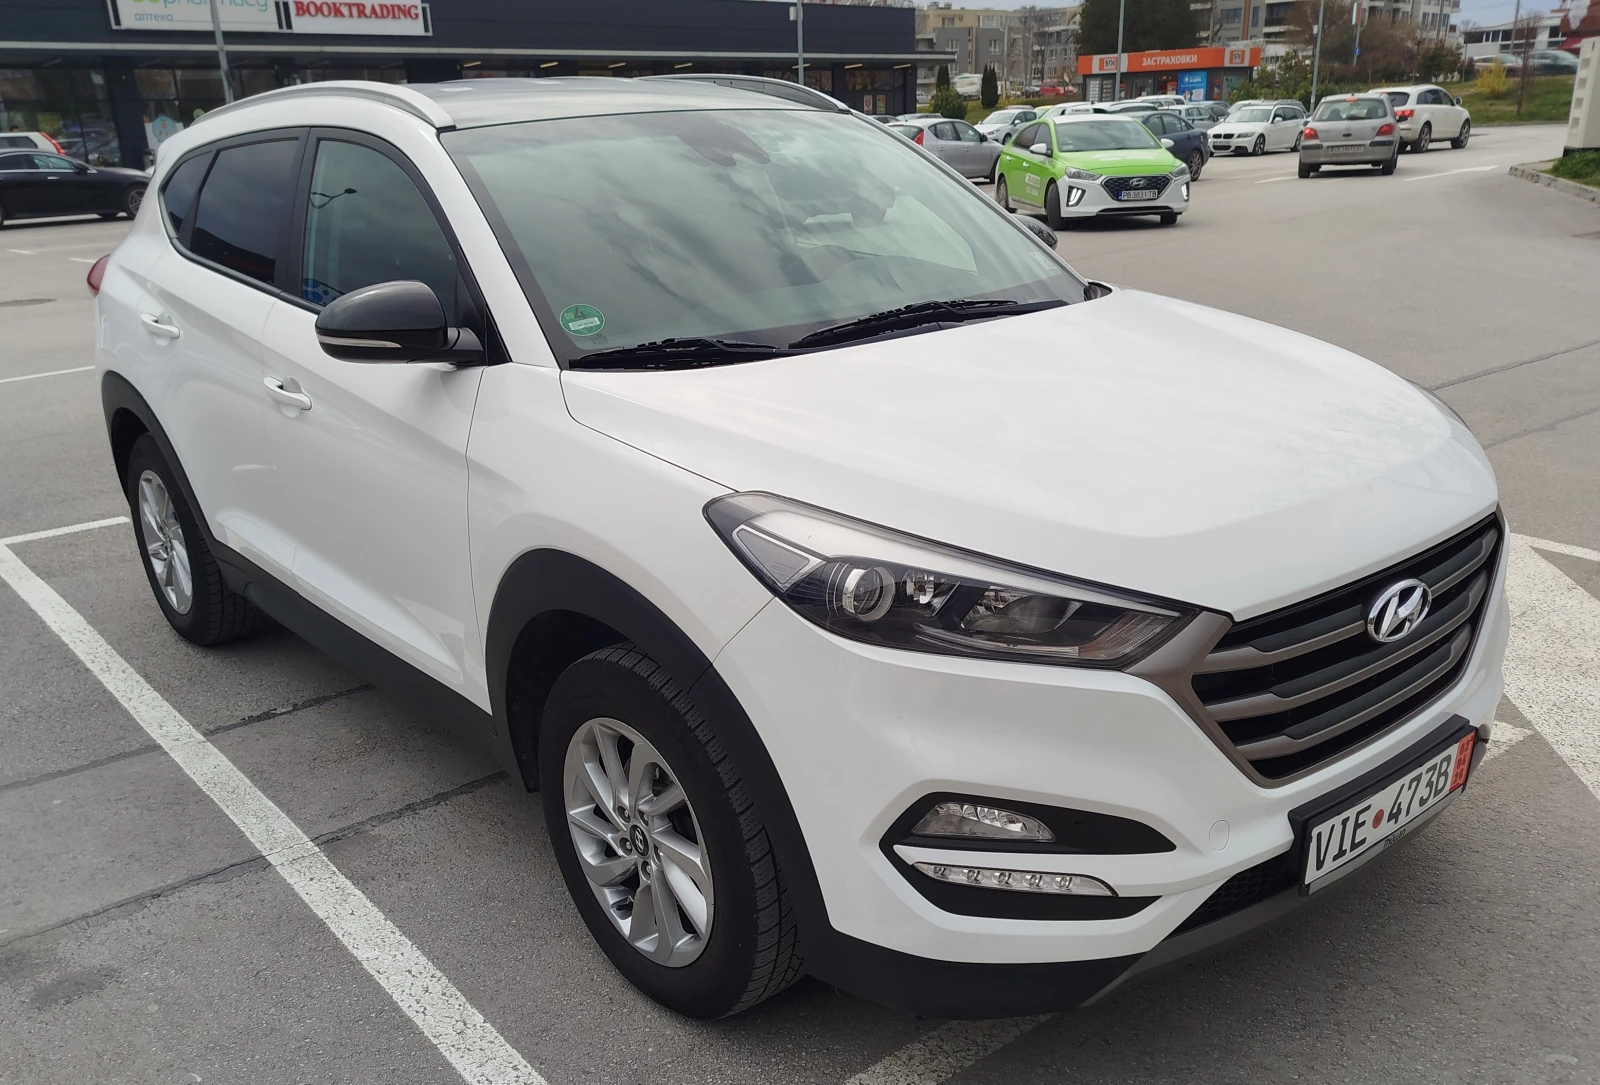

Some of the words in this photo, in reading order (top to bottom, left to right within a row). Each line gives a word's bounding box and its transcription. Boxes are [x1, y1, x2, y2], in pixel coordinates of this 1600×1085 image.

[135, 12, 174, 22] аптека
[293, 1, 419, 20] BOOKTRADING
[1142, 54, 1198, 67] ЗАСТРАХОВКИ
[1316, 804, 1372, 871] VIE
[1387, 754, 1452, 824] 473B
